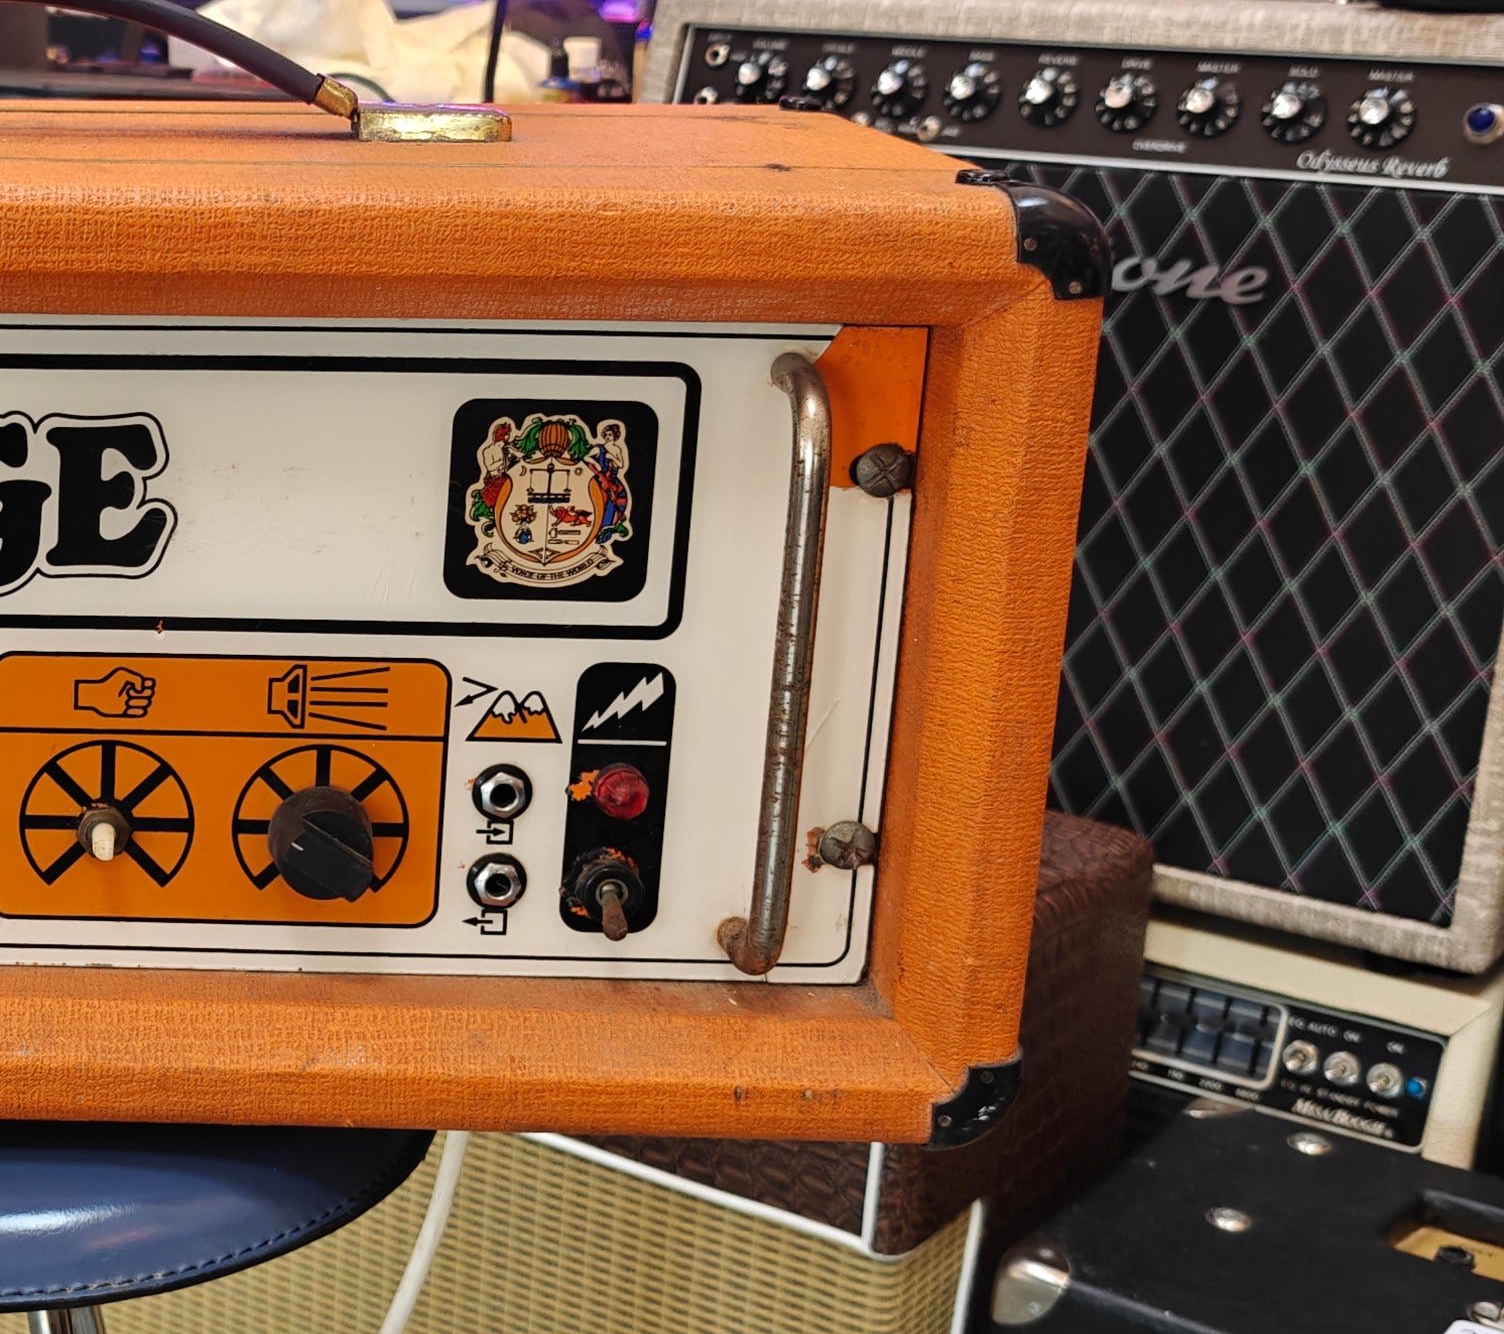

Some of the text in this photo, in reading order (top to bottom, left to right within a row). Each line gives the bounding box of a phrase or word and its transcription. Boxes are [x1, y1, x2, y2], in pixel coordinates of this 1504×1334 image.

[1296, 149, 1450, 179] Odysseus Reverb
[1111, 255, 1269, 304] one
